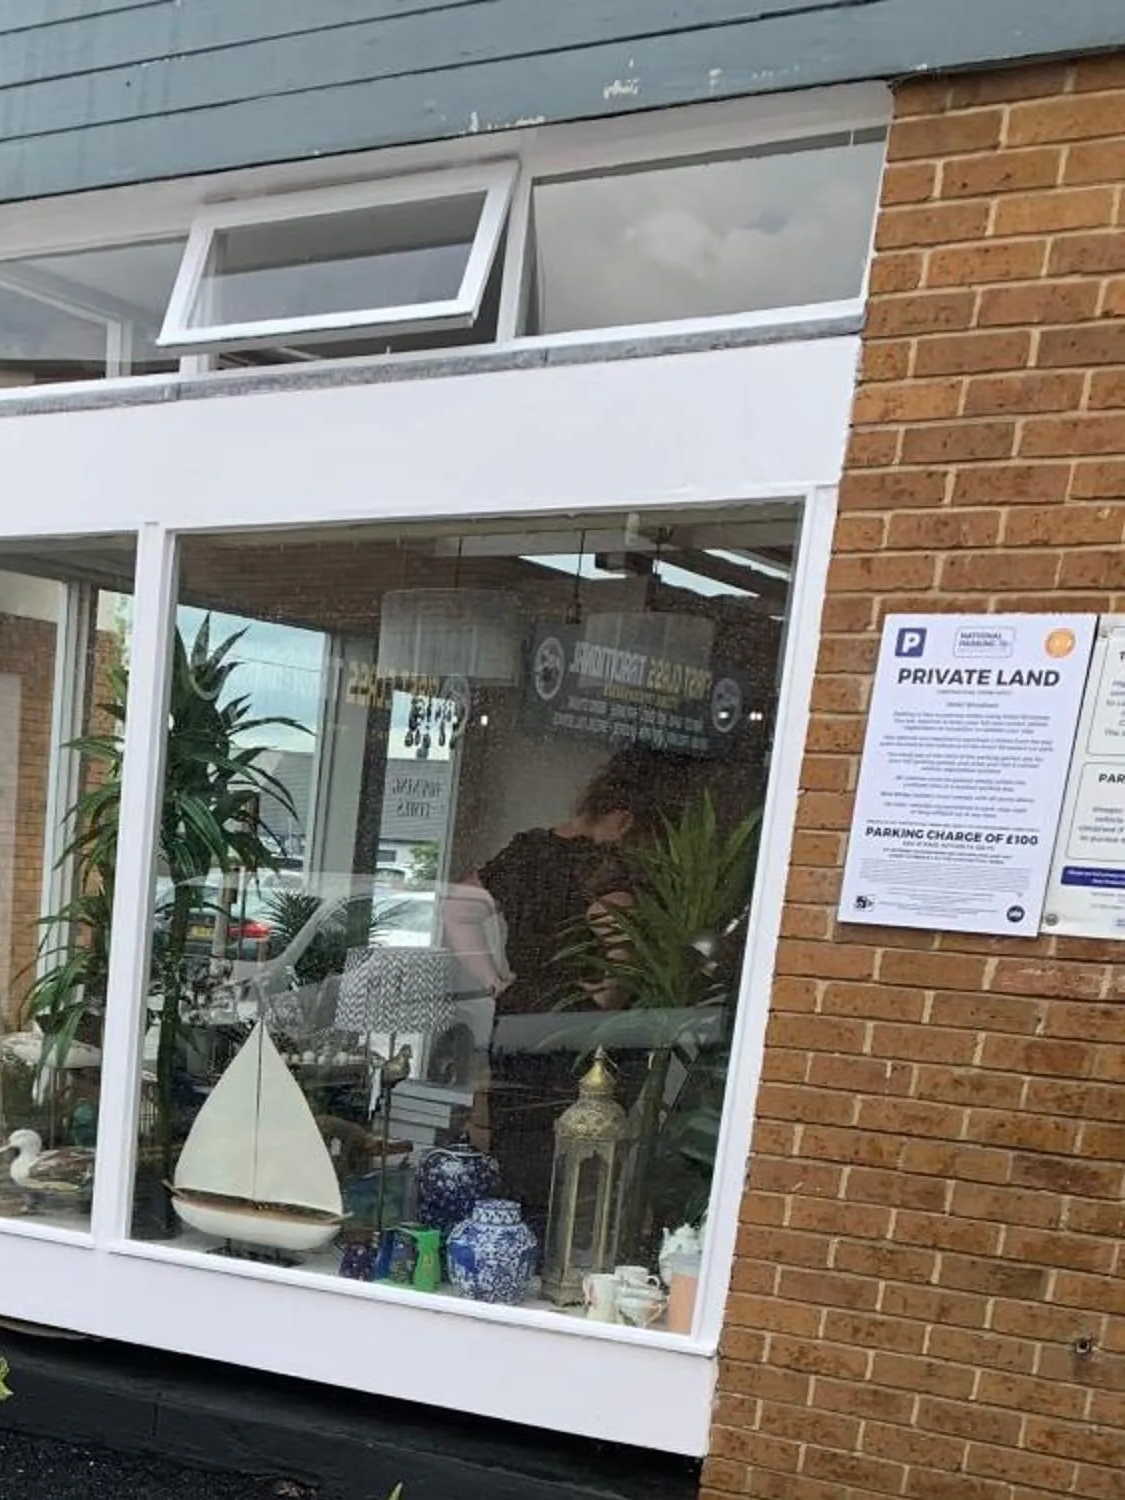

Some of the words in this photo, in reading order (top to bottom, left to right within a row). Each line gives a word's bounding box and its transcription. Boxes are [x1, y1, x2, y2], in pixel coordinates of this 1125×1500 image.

[897, 668, 992, 685] PRIVATE
[996, 669, 1060, 687] LAND
[865, 826, 924, 840] PARKING
[926, 829, 982, 843] CHARGE
[984, 833, 1004, 844] OF
[1006, 835, 1039, 846] £100
